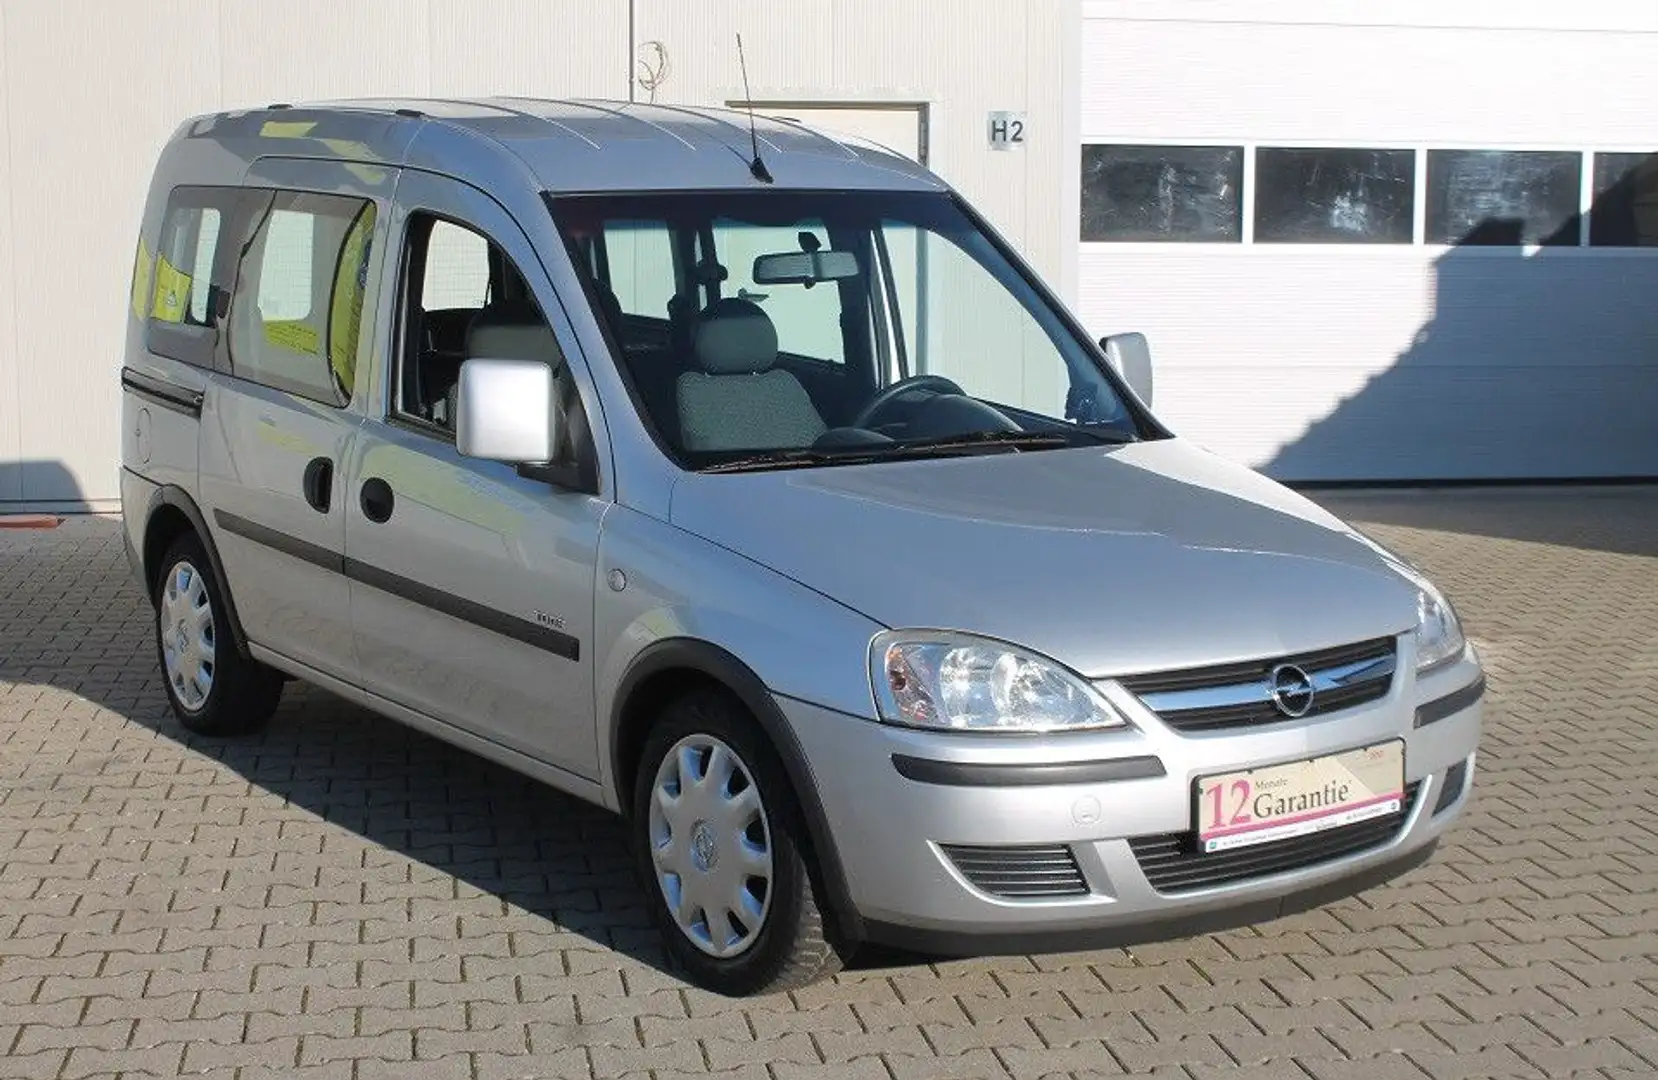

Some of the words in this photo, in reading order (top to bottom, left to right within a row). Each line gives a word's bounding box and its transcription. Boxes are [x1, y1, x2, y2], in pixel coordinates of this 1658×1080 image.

[991, 120, 1024, 142] H2
[1206, 779, 1251, 829] 12
[1254, 779, 1349, 818] Garantie
